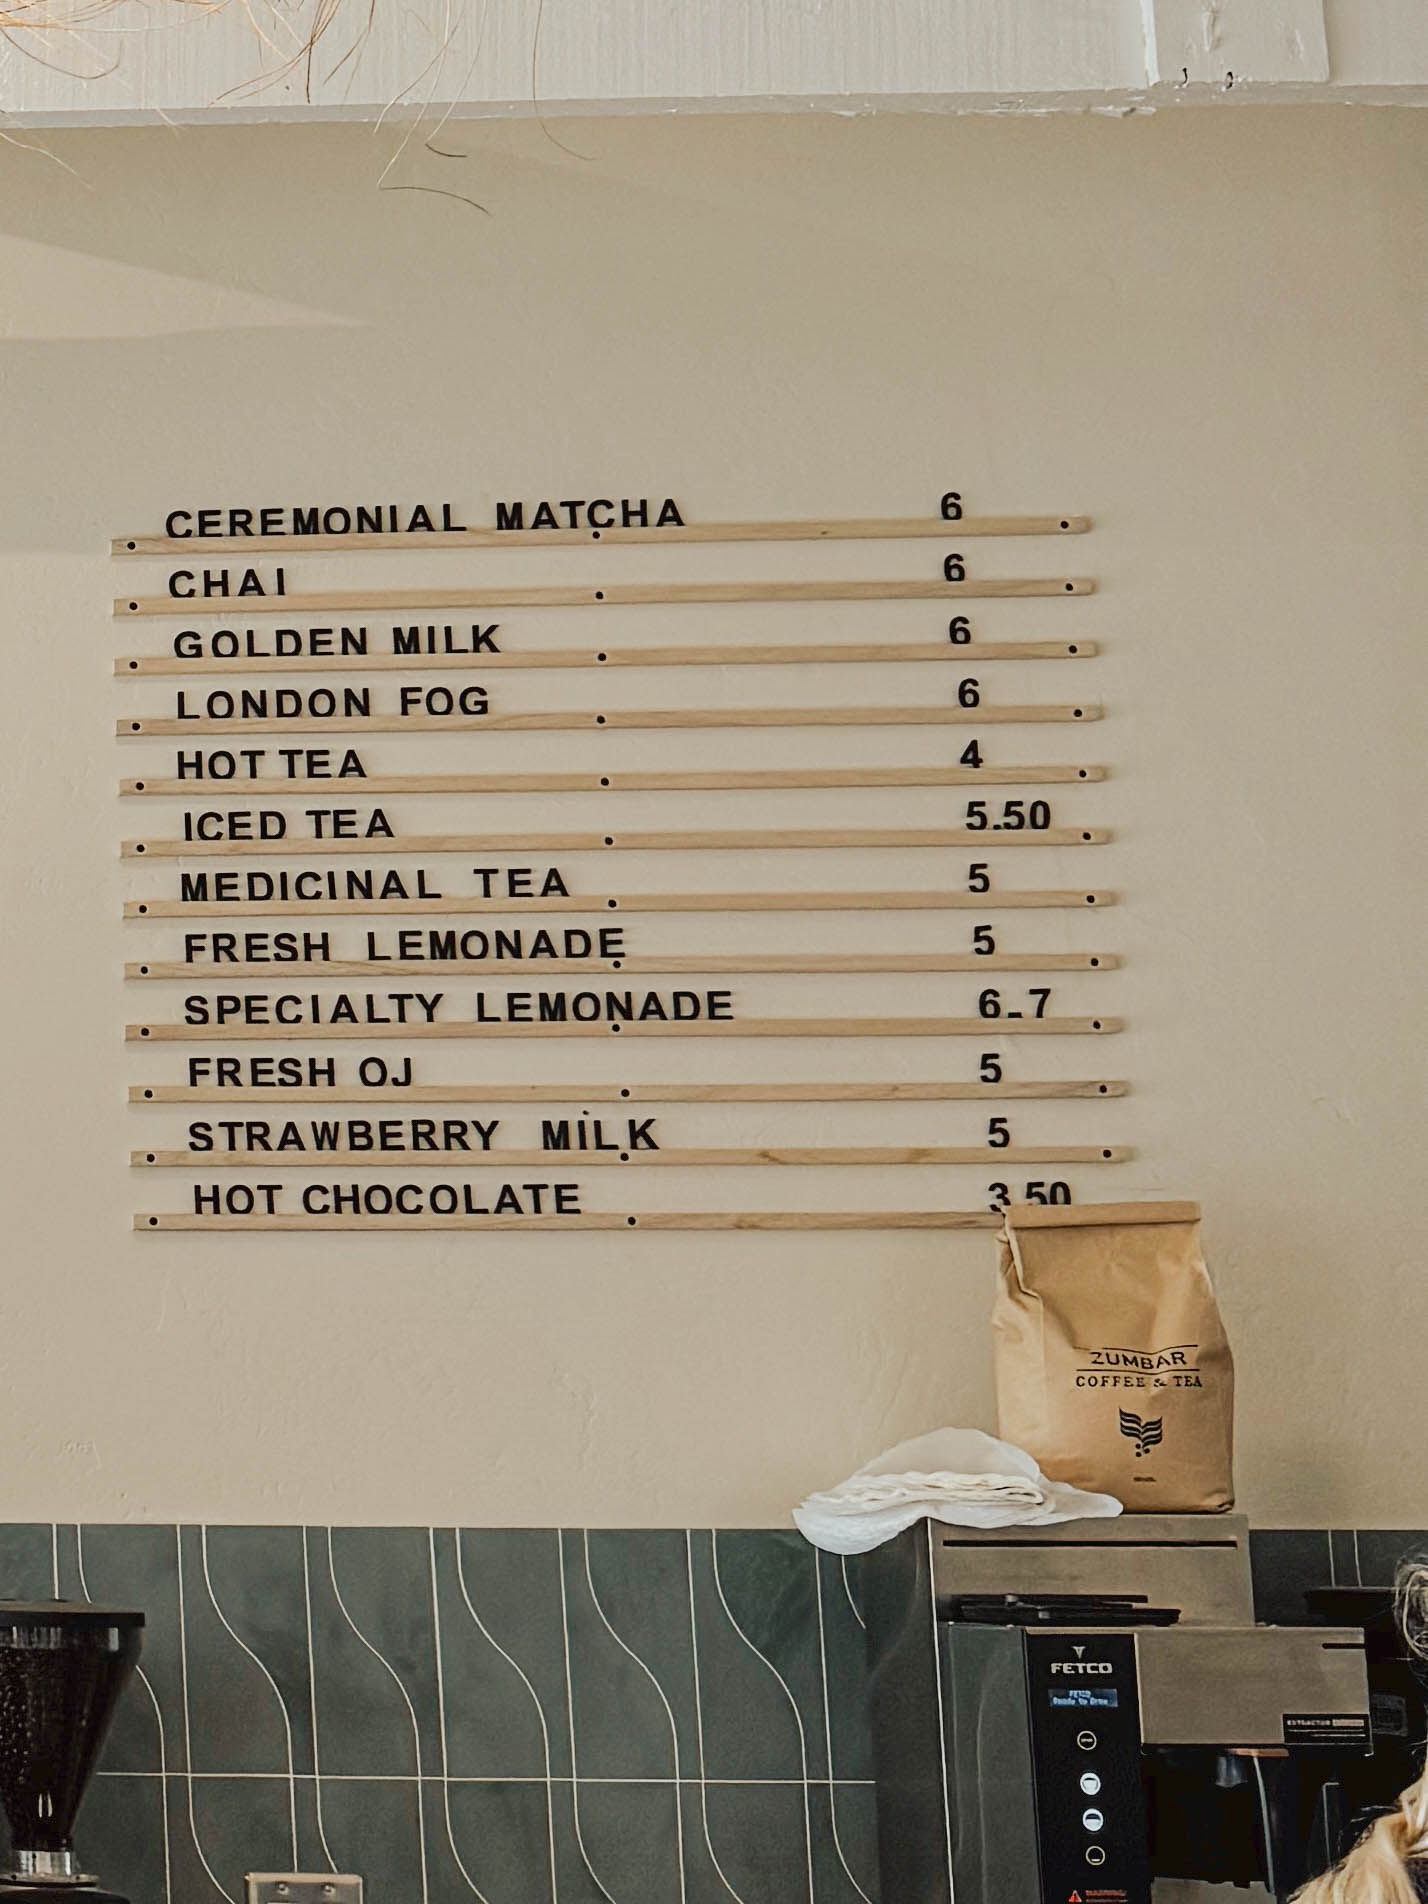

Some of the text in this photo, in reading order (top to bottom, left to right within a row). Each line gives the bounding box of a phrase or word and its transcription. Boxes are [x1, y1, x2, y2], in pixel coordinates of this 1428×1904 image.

[165, 491, 963, 539] CEREMONIAL MATCHA 6
[168, 553, 966, 599] CHAI 6
[173, 615, 972, 659] GOLDEN MILK 6
[177, 678, 980, 720] LONDON FOG 6
[177, 739, 984, 780] HOT TEA 4
[184, 799, 1051, 842] ICED TEA 5.50
[181, 863, 991, 902] MEDICINAL TEA 5
[184, 924, 996, 964] FRESH LEMONADE 5
[184, 993, 444, 1025] SPECIALTY
[476, 990, 734, 1023] LEMONADE
[188, 1053, 1003, 1088] FRESH OJ 5
[188, 1117, 1011, 1152] STRAWBERRY MILK 5
[194, 1181, 1072, 1215] HOT CHOCOLATE 350
[1090, 1351, 1187, 1370] ZUMBAR
[1075, 1375, 1146, 1388] COFFEE
[1173, 1375, 1203, 1388] TEA
[1050, 1662, 1113, 1674] FETCO
